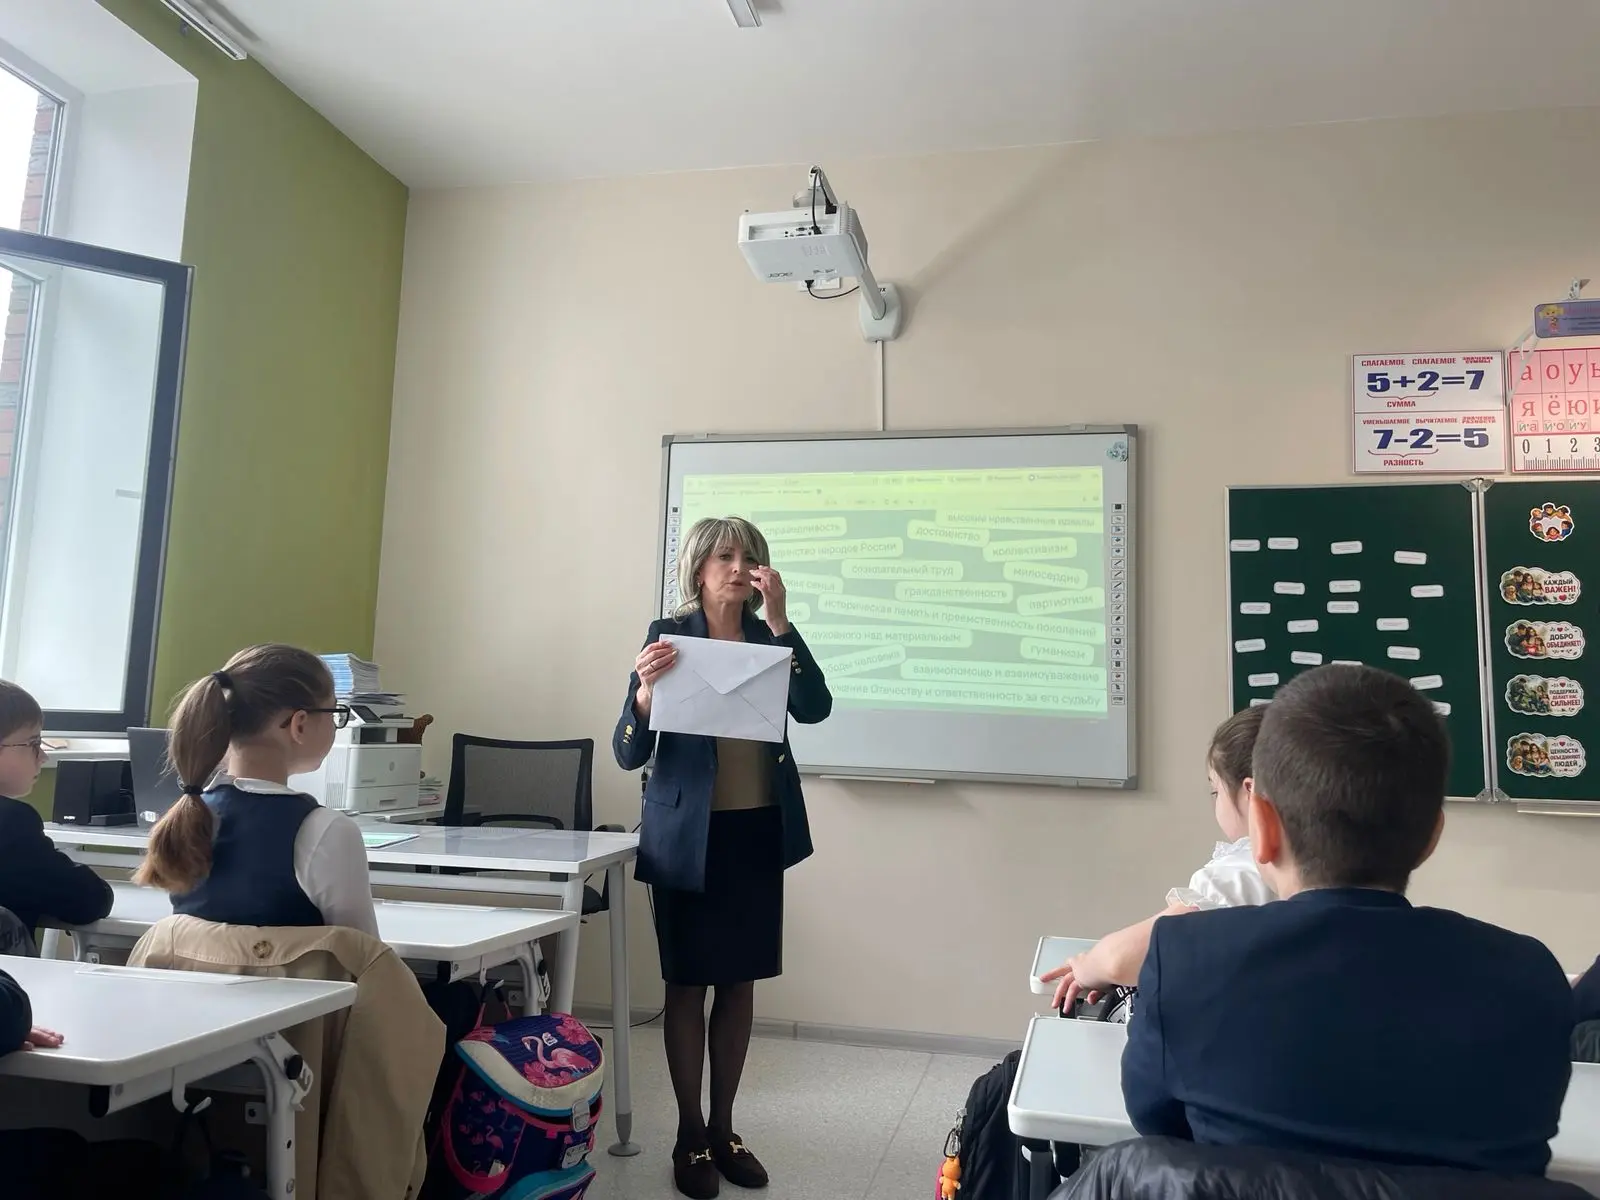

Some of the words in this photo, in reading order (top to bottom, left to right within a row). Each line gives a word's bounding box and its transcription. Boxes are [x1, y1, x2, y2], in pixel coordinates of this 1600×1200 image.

[1361, 358, 1405, 366] СЛАГАЕМОЕ
[1412, 357, 1457, 365] СЛАГАЕМОЕ
[1520, 364, 1533, 381] а
[1546, 364, 1560, 380] о
[1568, 363, 1584, 385] у
[1367, 369, 1485, 393] 5+2=7
[1387, 400, 1416, 408] СУММА
[1521, 401, 1536, 417] я
[1547, 395, 1561, 416] ё
[1567, 399, 1588, 416] ю
[1522, 438, 1531, 454] 0
[1546, 438, 1552, 454] 1
[1569, 437, 1578, 453] 2
[1383, 459, 1424, 467] РАЗНОСТЬ
[915, 526, 981, 541] достоинство
[860, 540, 897, 552] России
[992, 544, 1068, 557] коллективизм
[852, 564, 928, 576] созидательный
[930, 565, 954, 577] труд
[1013, 567, 1080, 584] милосердие
[1543, 578, 1574, 586] КАЖДЫЙ
[904, 587, 1008, 600] гражданственность
[1544, 585, 1576, 594] ВАЖЕН!
[824, 599, 892, 614] историческая
[894, 604, 930, 618] память
[942, 612, 1034, 630] преемственность
[1037, 622, 1097, 637] поколений
[811, 632, 862, 642] духовного
[864, 632, 883, 642] над
[885, 632, 962, 643] материальным
[1549, 633, 1574, 641] ДОБРО
[913, 664, 993, 678] взаимопомощь
[1004, 668, 1100, 683] взаимоуважение
[870, 683, 923, 699] Отечеству
[935, 688, 1023, 702] ответственность
[1061, 693, 1101, 708] судьбу
[1550, 699, 1581, 707] СИЛЬНЕЕ!
